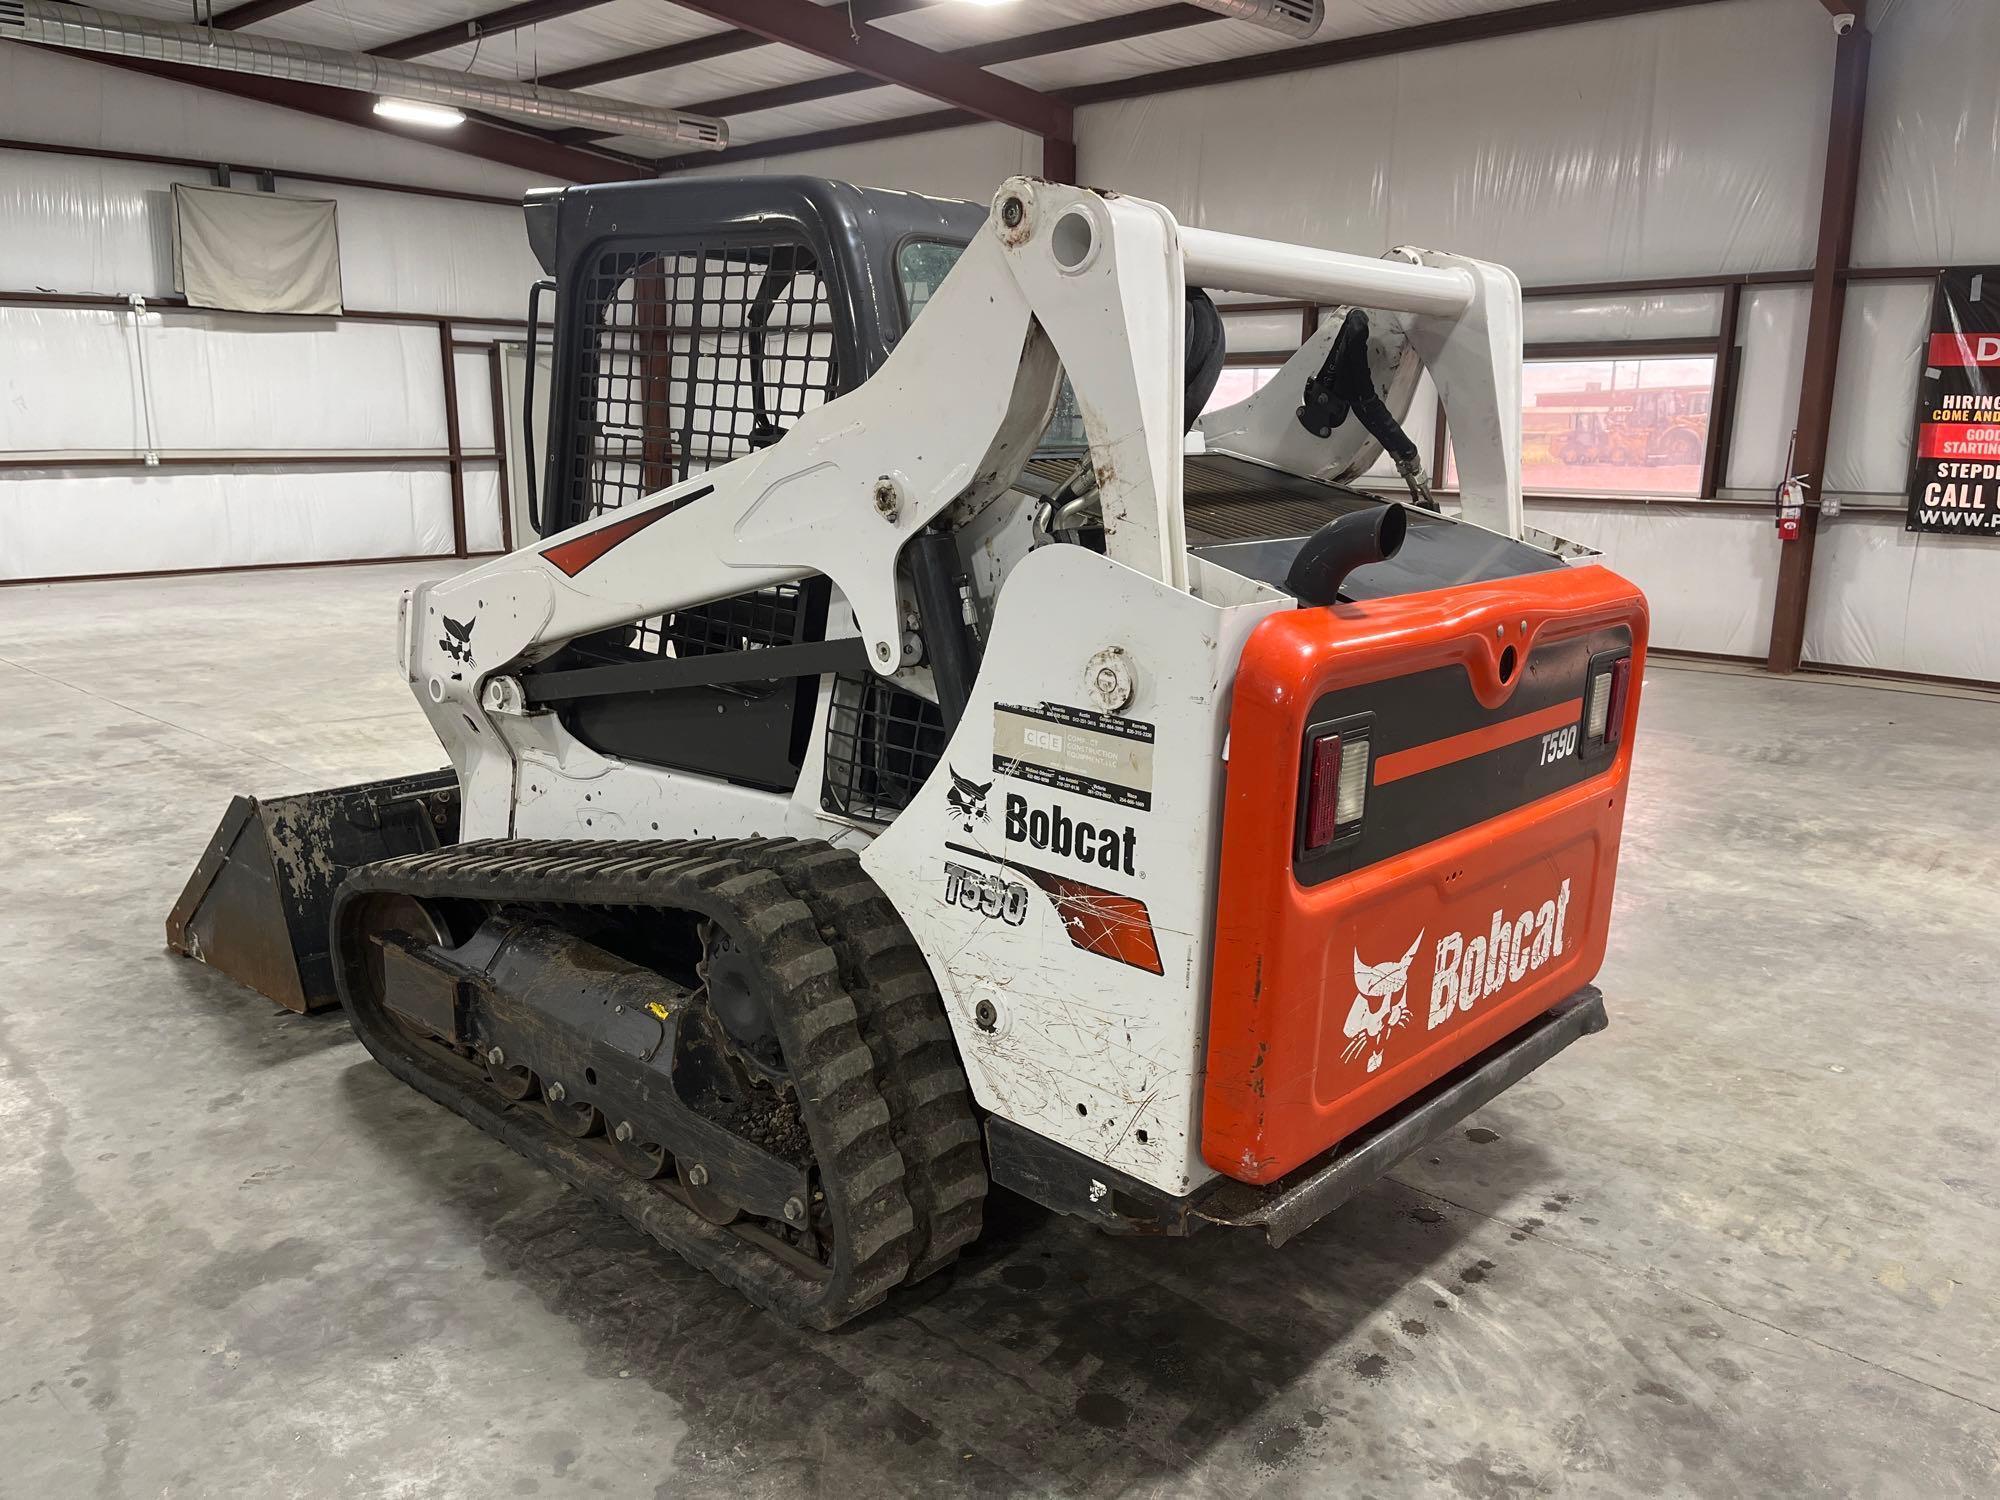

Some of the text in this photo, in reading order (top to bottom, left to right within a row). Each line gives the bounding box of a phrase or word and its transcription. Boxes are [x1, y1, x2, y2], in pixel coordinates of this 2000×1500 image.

[1932, 409, 2000, 422] COME AND
[1943, 441, 2000, 455] STARTIN
[1924, 482, 1986, 509] CALL
[1066, 742, 1119, 760] CONSTRUCTION
[1067, 734, 1098, 746] COMPCT
[1539, 725, 1579, 767] T590
[1005, 792, 1137, 876] Bobcat
[943, 861, 1029, 927] T590
[1427, 878, 1572, 1030] Bobcat
